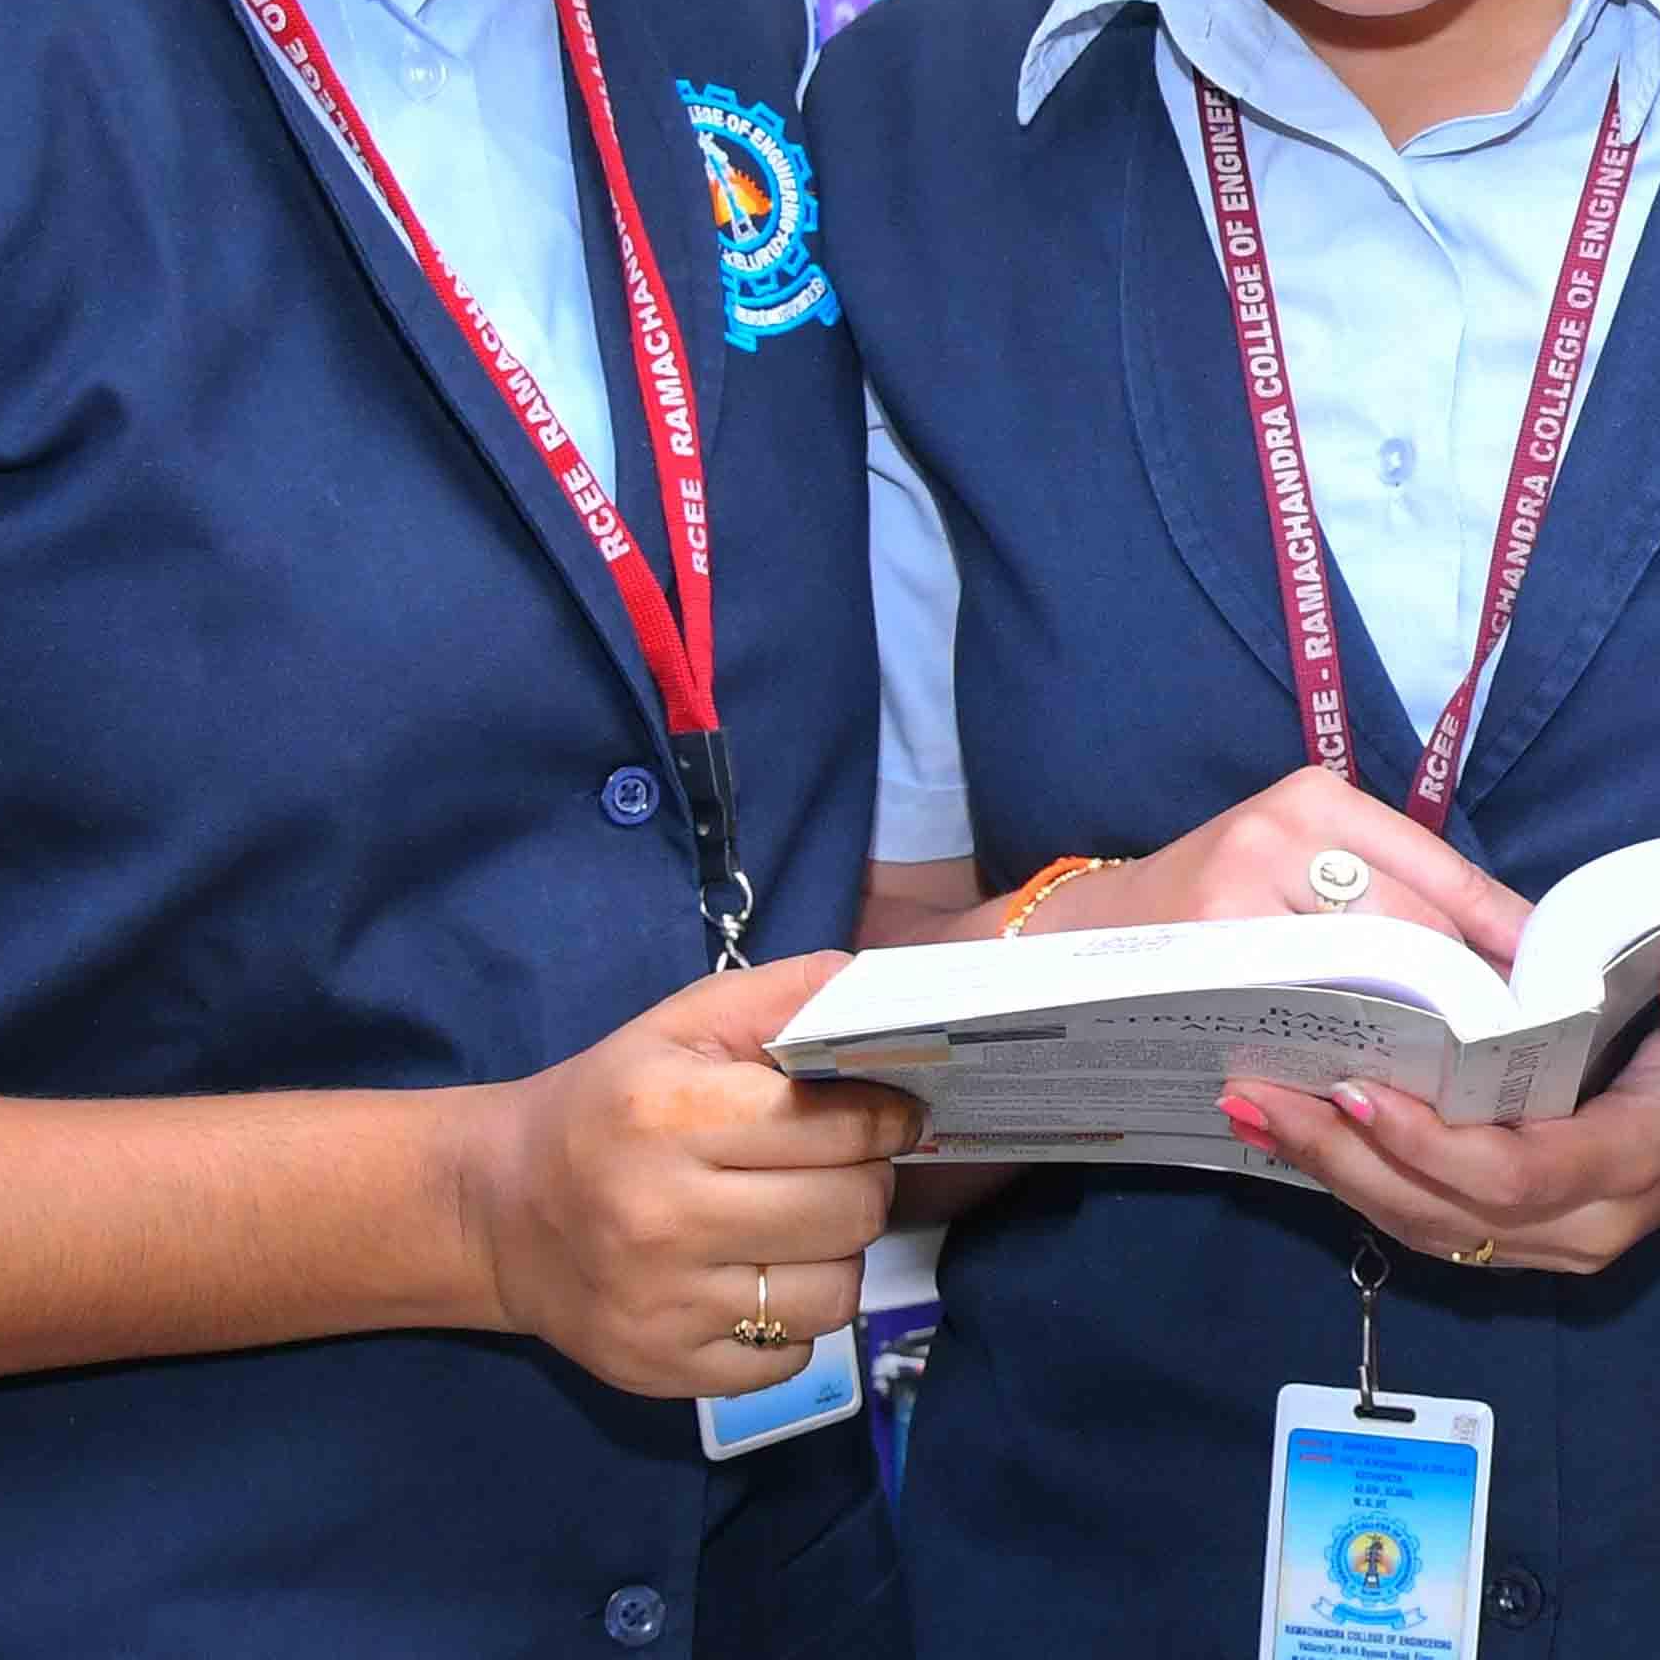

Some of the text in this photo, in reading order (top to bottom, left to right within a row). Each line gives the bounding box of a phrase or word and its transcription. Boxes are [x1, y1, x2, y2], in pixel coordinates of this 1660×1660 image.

[1226, 219, 1256, 259] OF
[1233, 256, 1284, 400] COLLEGE
[574, 469, 631, 563] RCEE
[690, 477, 707, 578] RCEE
[1263, 405, 1332, 664] RAMACHANDRA
[1419, 270, 1598, 803] RCEE COLLEGE OF
